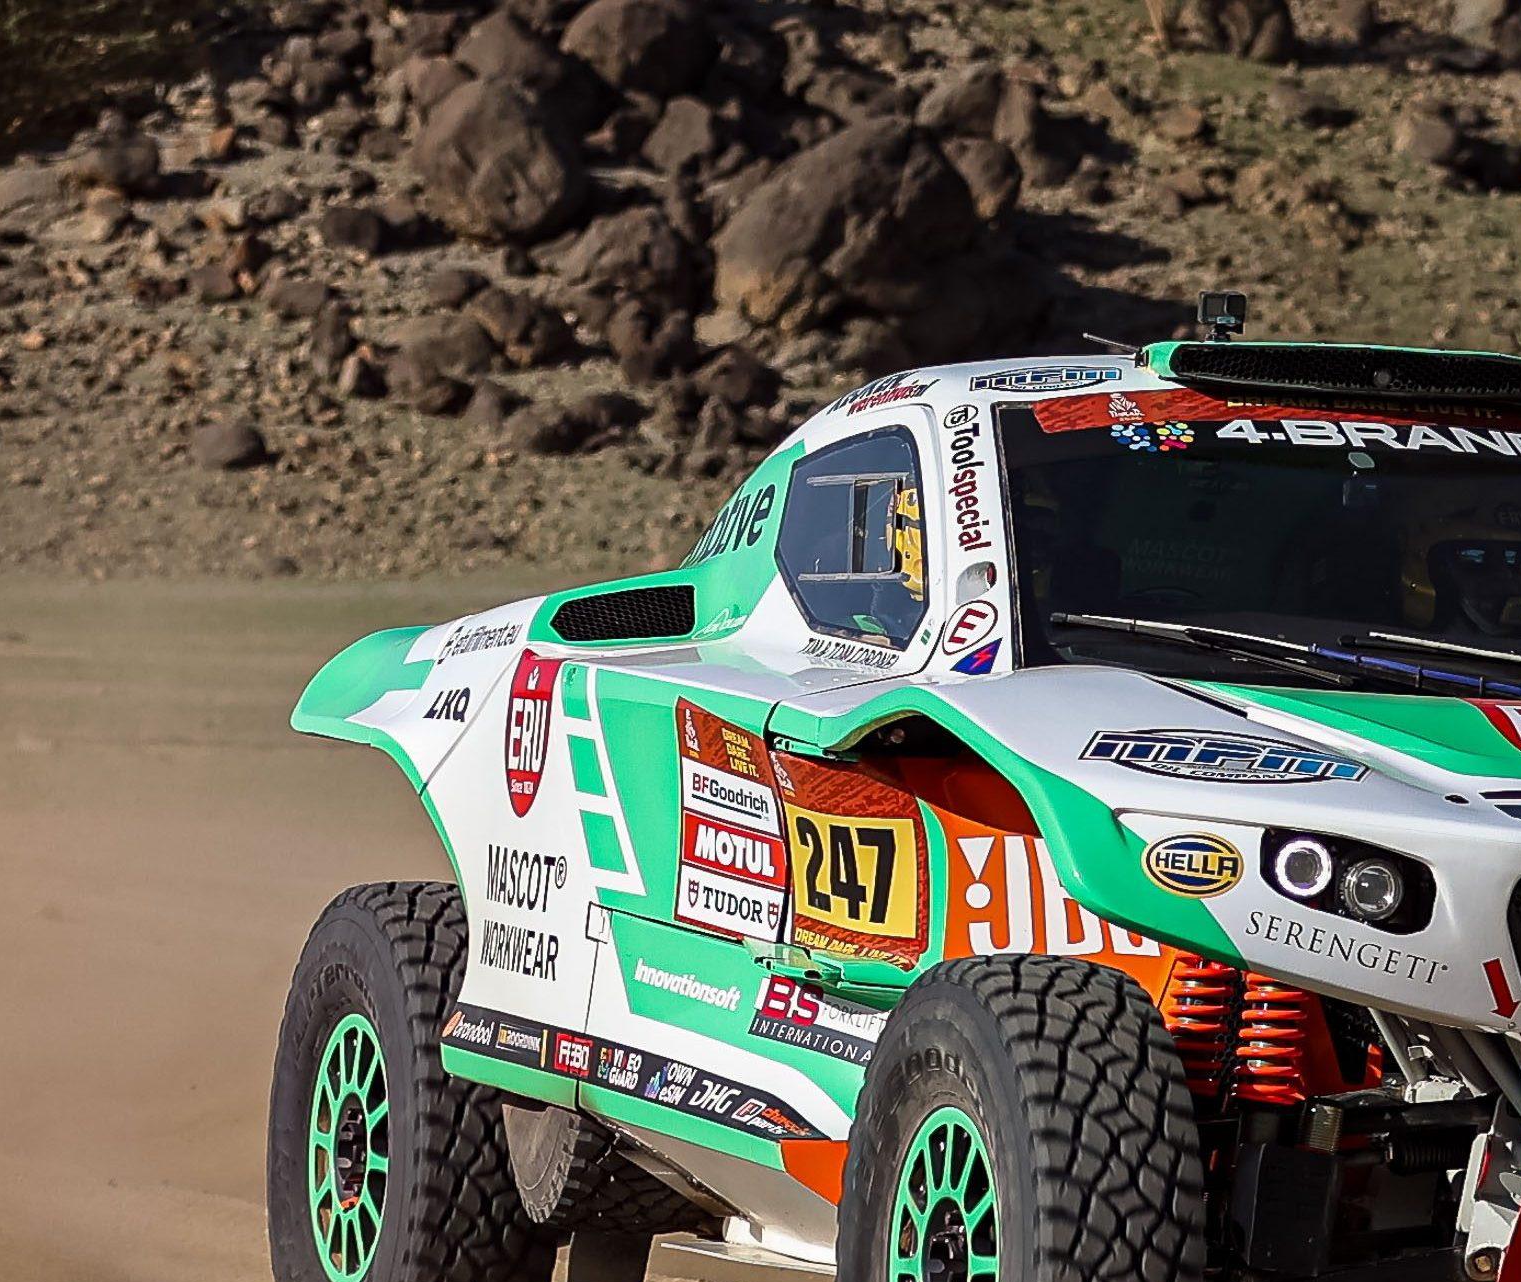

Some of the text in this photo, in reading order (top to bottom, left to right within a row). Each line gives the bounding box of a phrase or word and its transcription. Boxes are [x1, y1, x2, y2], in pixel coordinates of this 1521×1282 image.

[947, 422, 992, 552] Toolspecial
[423, 687, 471, 722] LKQ
[509, 696, 550, 773] ERU
[692, 772, 769, 814] BFGoodrich
[1187, 769, 1289, 780] COMPANY
[694, 824, 775, 877] MOTUL
[795, 816, 898, 924] 247
[1154, 849, 1240, 879] HELLA
[703, 884, 763, 924] TUDOR
[479, 919, 559, 982] WORKWEAR
[1244, 910, 1443, 985] SERENGETI
[633, 957, 742, 1012] Innovationsoft
[752, 1017, 872, 1063] INTERNATIONA
[689, 1079, 742, 1115] DHG
